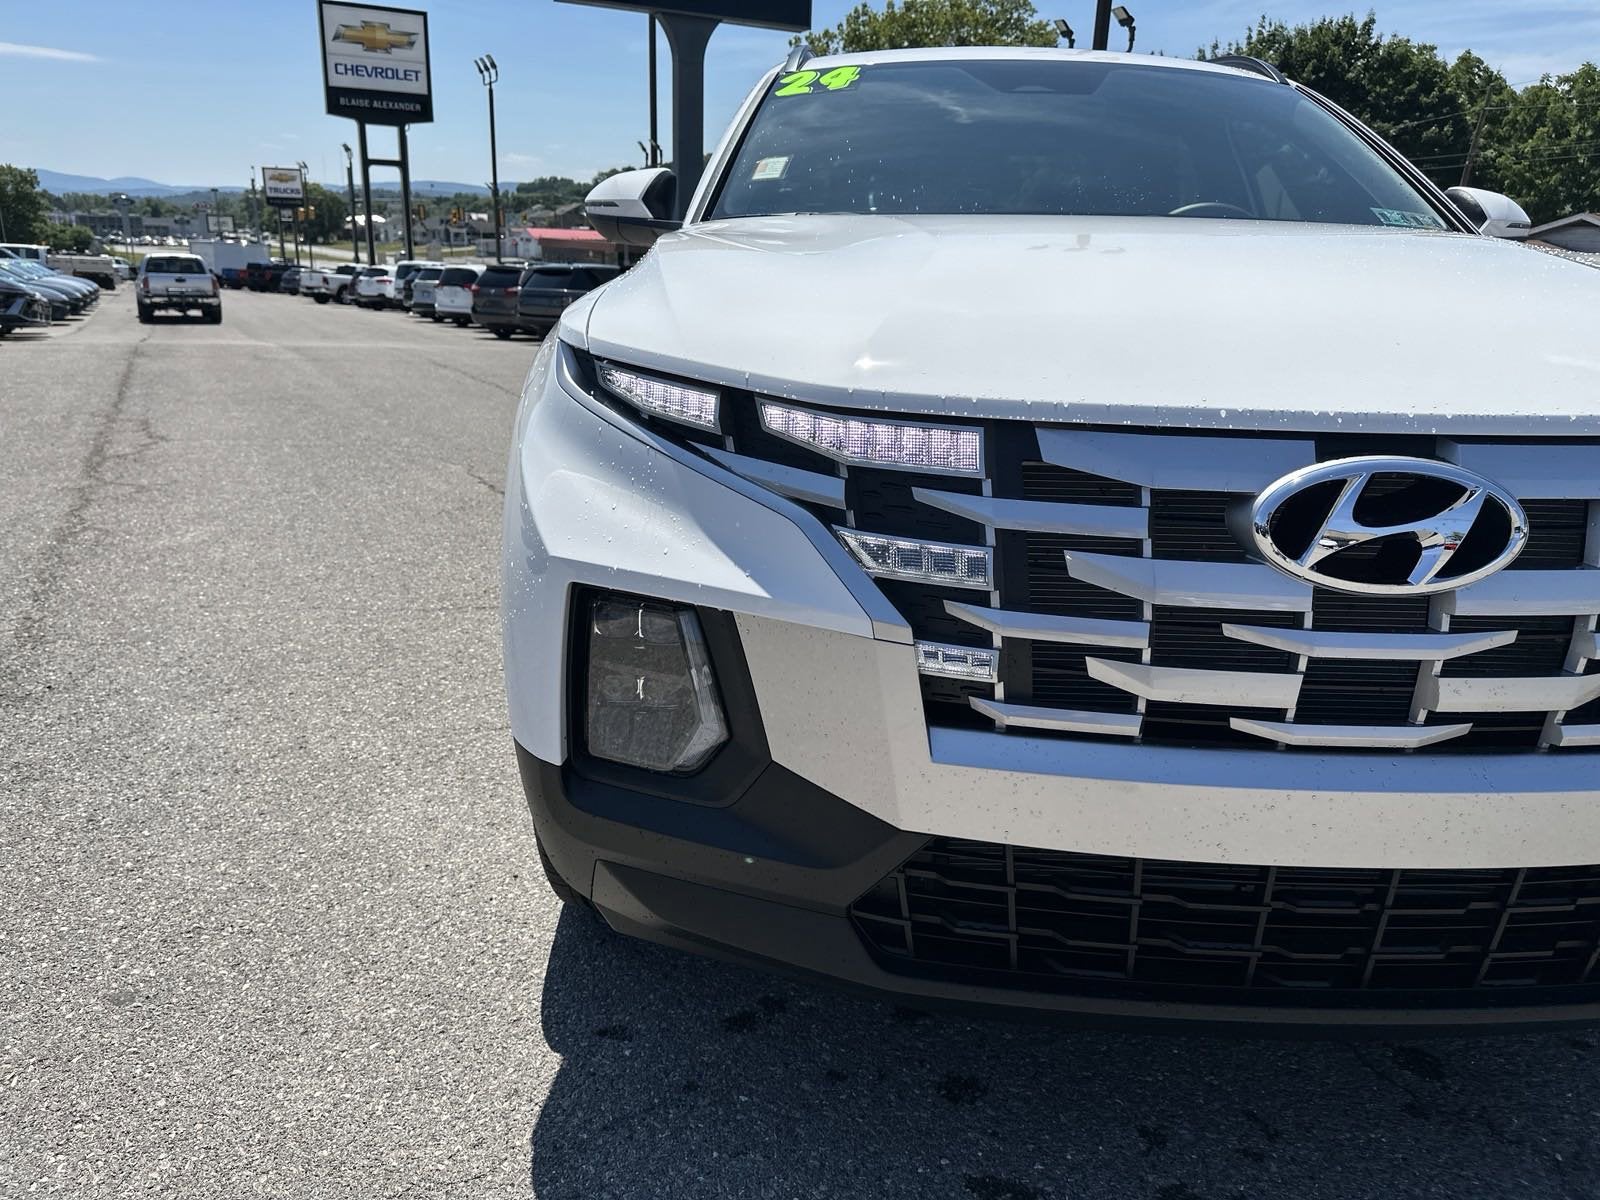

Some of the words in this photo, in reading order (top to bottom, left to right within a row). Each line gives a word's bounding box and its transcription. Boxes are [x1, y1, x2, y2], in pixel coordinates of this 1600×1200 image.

[334, 63, 421, 82] CHEVROLET
[775, 66, 861, 97] 24
[340, 97, 371, 108] BLAISE
[372, 100, 421, 112] ALEXANDER
[268, 187, 301, 195] TRUCKS
